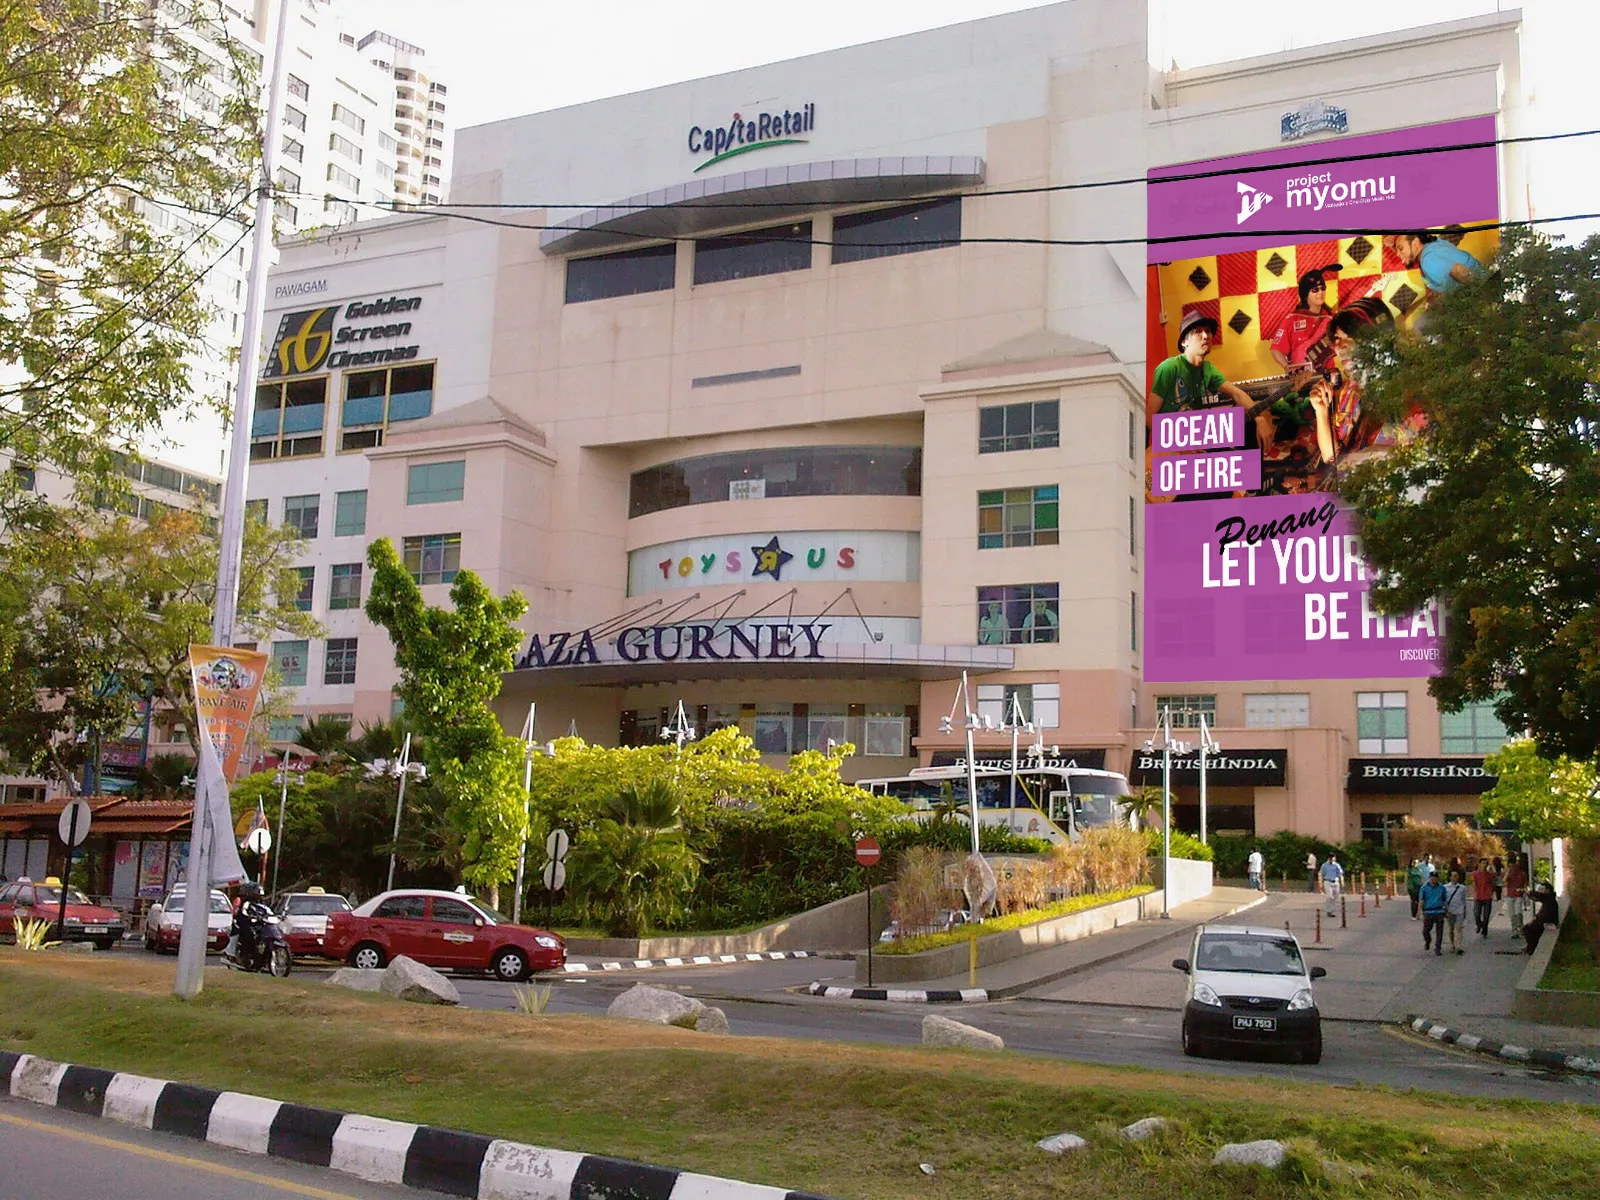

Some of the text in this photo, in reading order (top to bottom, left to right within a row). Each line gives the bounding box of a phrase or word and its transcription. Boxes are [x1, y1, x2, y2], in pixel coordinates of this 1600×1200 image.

[688, 103, 815, 155] CapitaRetail
[1287, 172, 1331, 190] project
[1287, 176, 1395, 211] myomu
[275, 280, 327, 297] PAWAGAM
[344, 296, 422, 320] Golden
[334, 321, 412, 344] Screen
[326, 345, 419, 369] Cinemas
[1160, 412, 1233, 448] OCEAN
[1160, 455, 1243, 491] OF FIRE
[1215, 501, 1339, 555] Penang
[659, 551, 742, 579] TOYS
[807, 547, 855, 569] US
[1203, 534, 1366, 587] LET YOUR
[1305, 591, 1349, 640] BE
[513, 624, 833, 669] AZA GURNEY
[1400, 648, 1440, 661] DISCOVER
